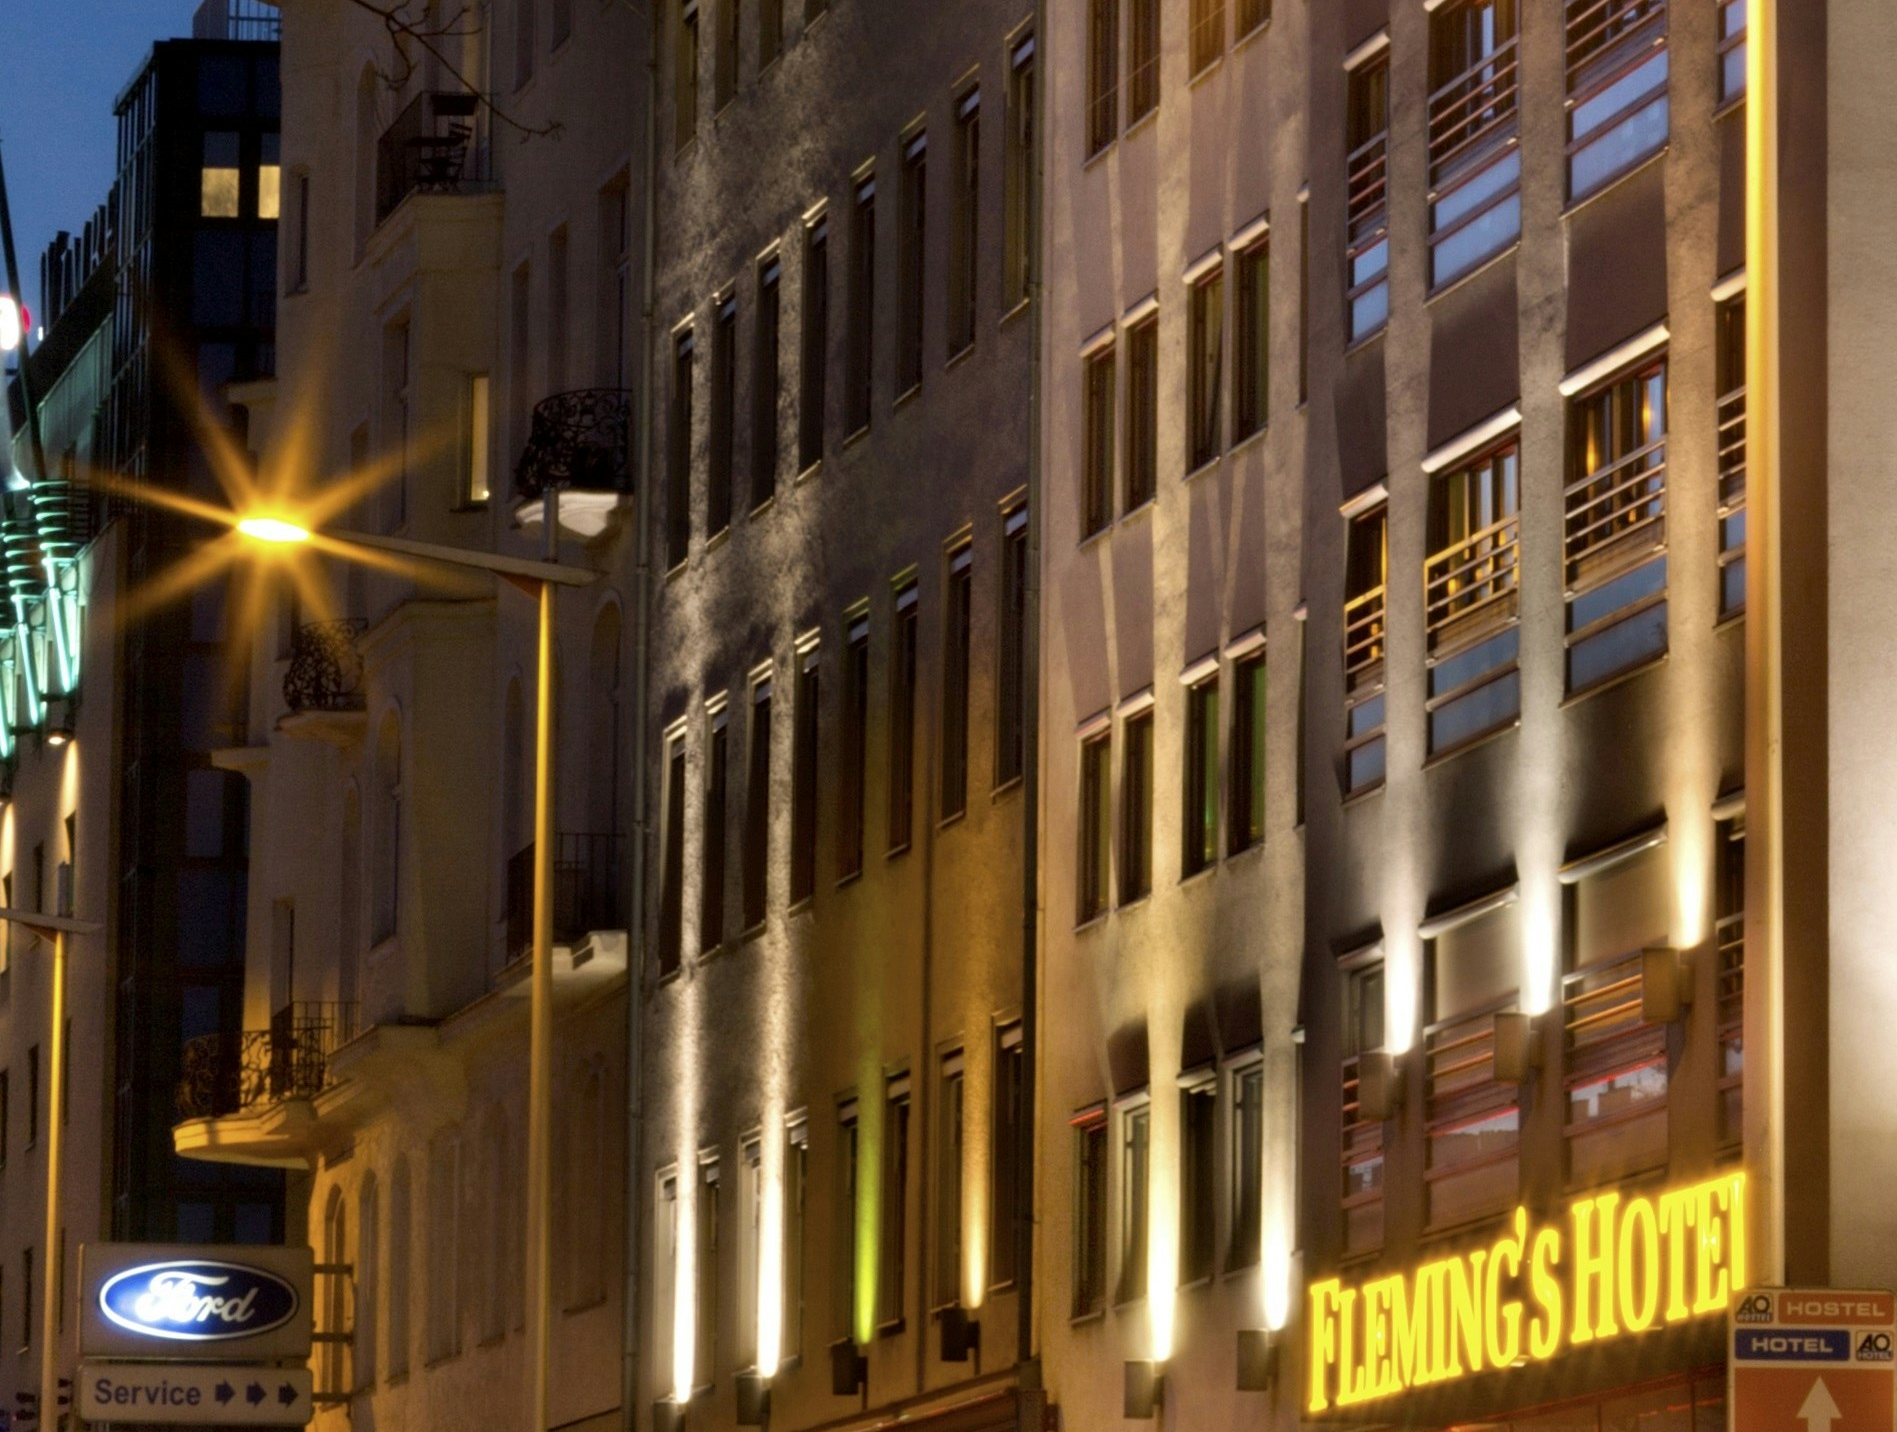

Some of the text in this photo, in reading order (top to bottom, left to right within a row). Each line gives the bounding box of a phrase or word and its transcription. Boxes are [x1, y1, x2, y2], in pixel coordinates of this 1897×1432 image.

[135, 1270, 260, 1323] Ford
[1308, 1206, 1561, 1413] FLEMING'S
[1787, 1301, 1885, 1317] HOSTEL
[1752, 1338, 1833, 1353] HOTEL
[95, 1378, 200, 1405] Service
